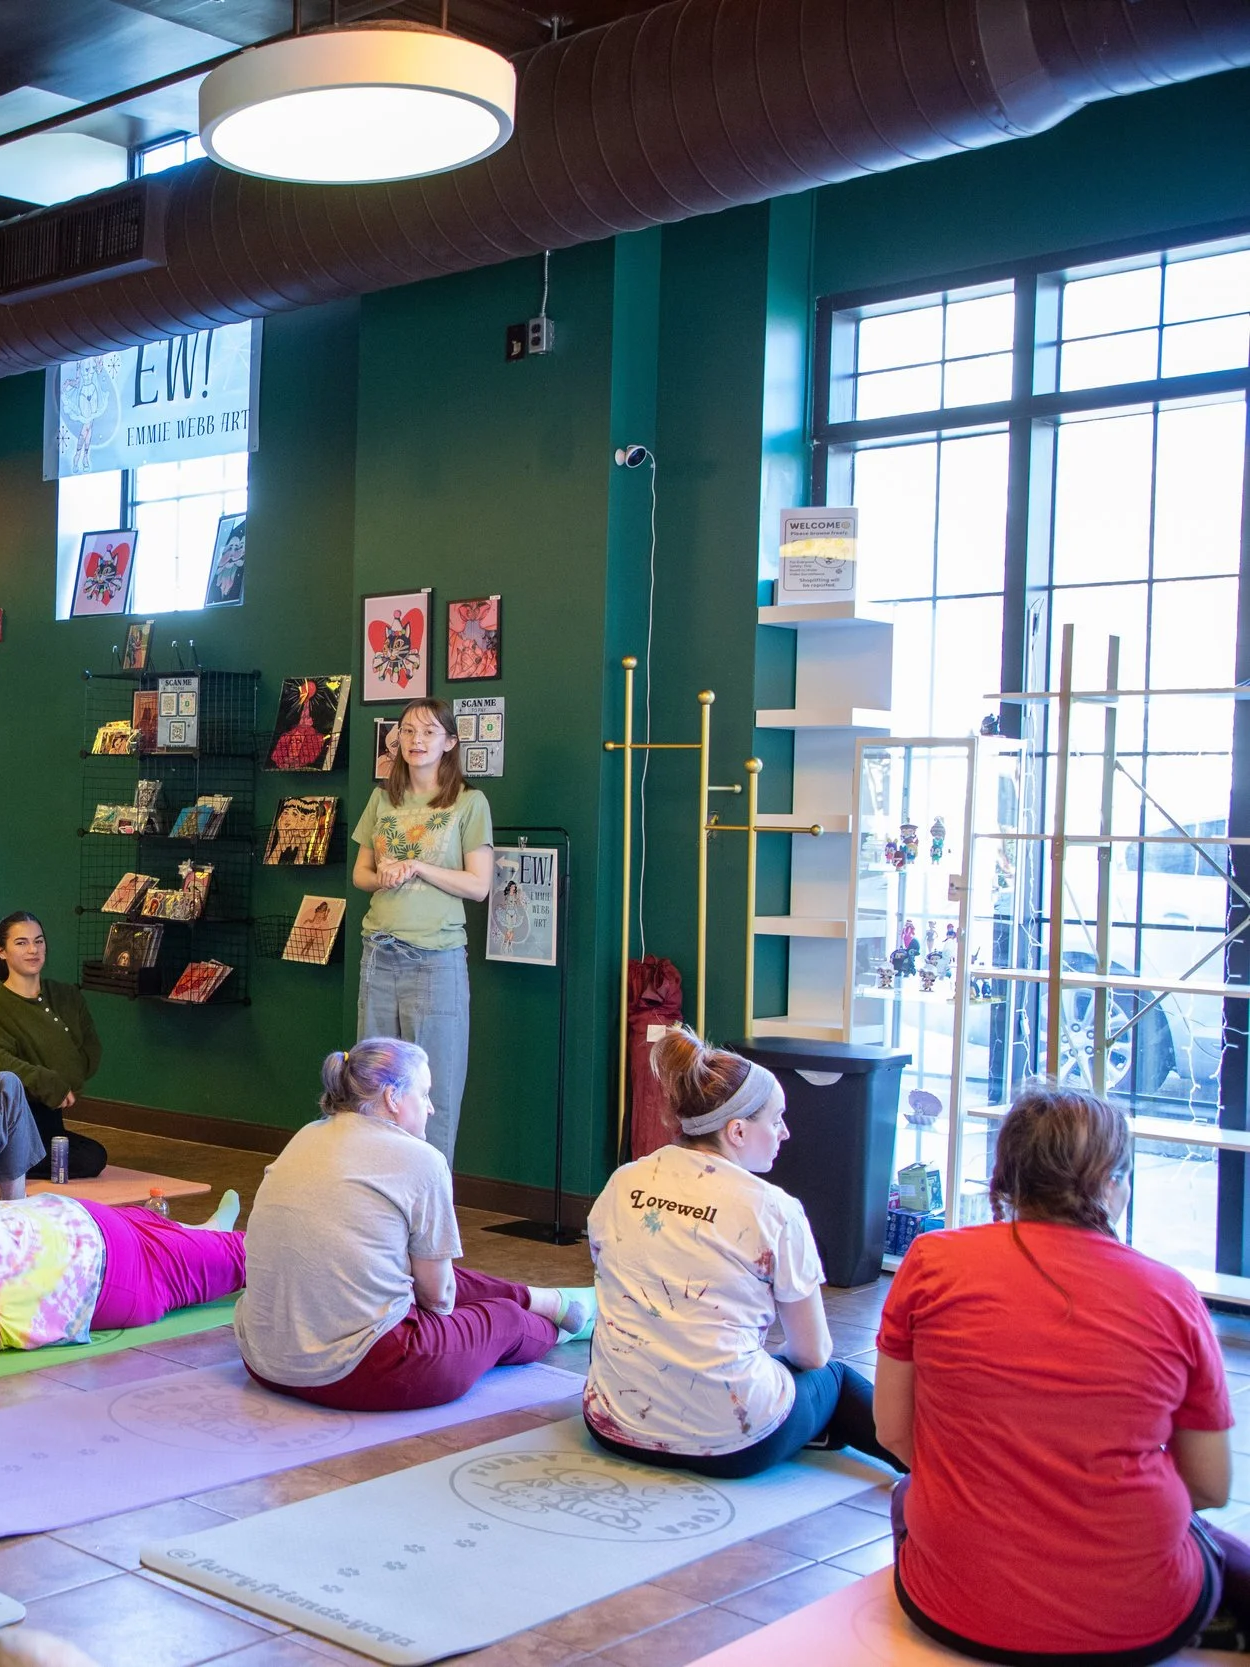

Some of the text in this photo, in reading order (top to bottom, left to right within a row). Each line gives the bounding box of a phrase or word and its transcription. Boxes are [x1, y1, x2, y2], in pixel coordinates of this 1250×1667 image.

[132, 328, 214, 408] EW!
[126, 408, 251, 447] EMMIE WEBB ART
[790, 521, 841, 530] WELCOME
[165, 679, 182, 687] SCAN
[461, 698, 497, 708] SCAN ME
[519, 854, 554, 887] EW!
[532, 904, 550, 915] WEBB
[630, 1189, 718, 1224] Lovewell
[467, 1454, 558, 1477] FURRY
[654, 1507, 721, 1535] YOGA
[166, 1548, 416, 1648] @furry.friends.yoga
